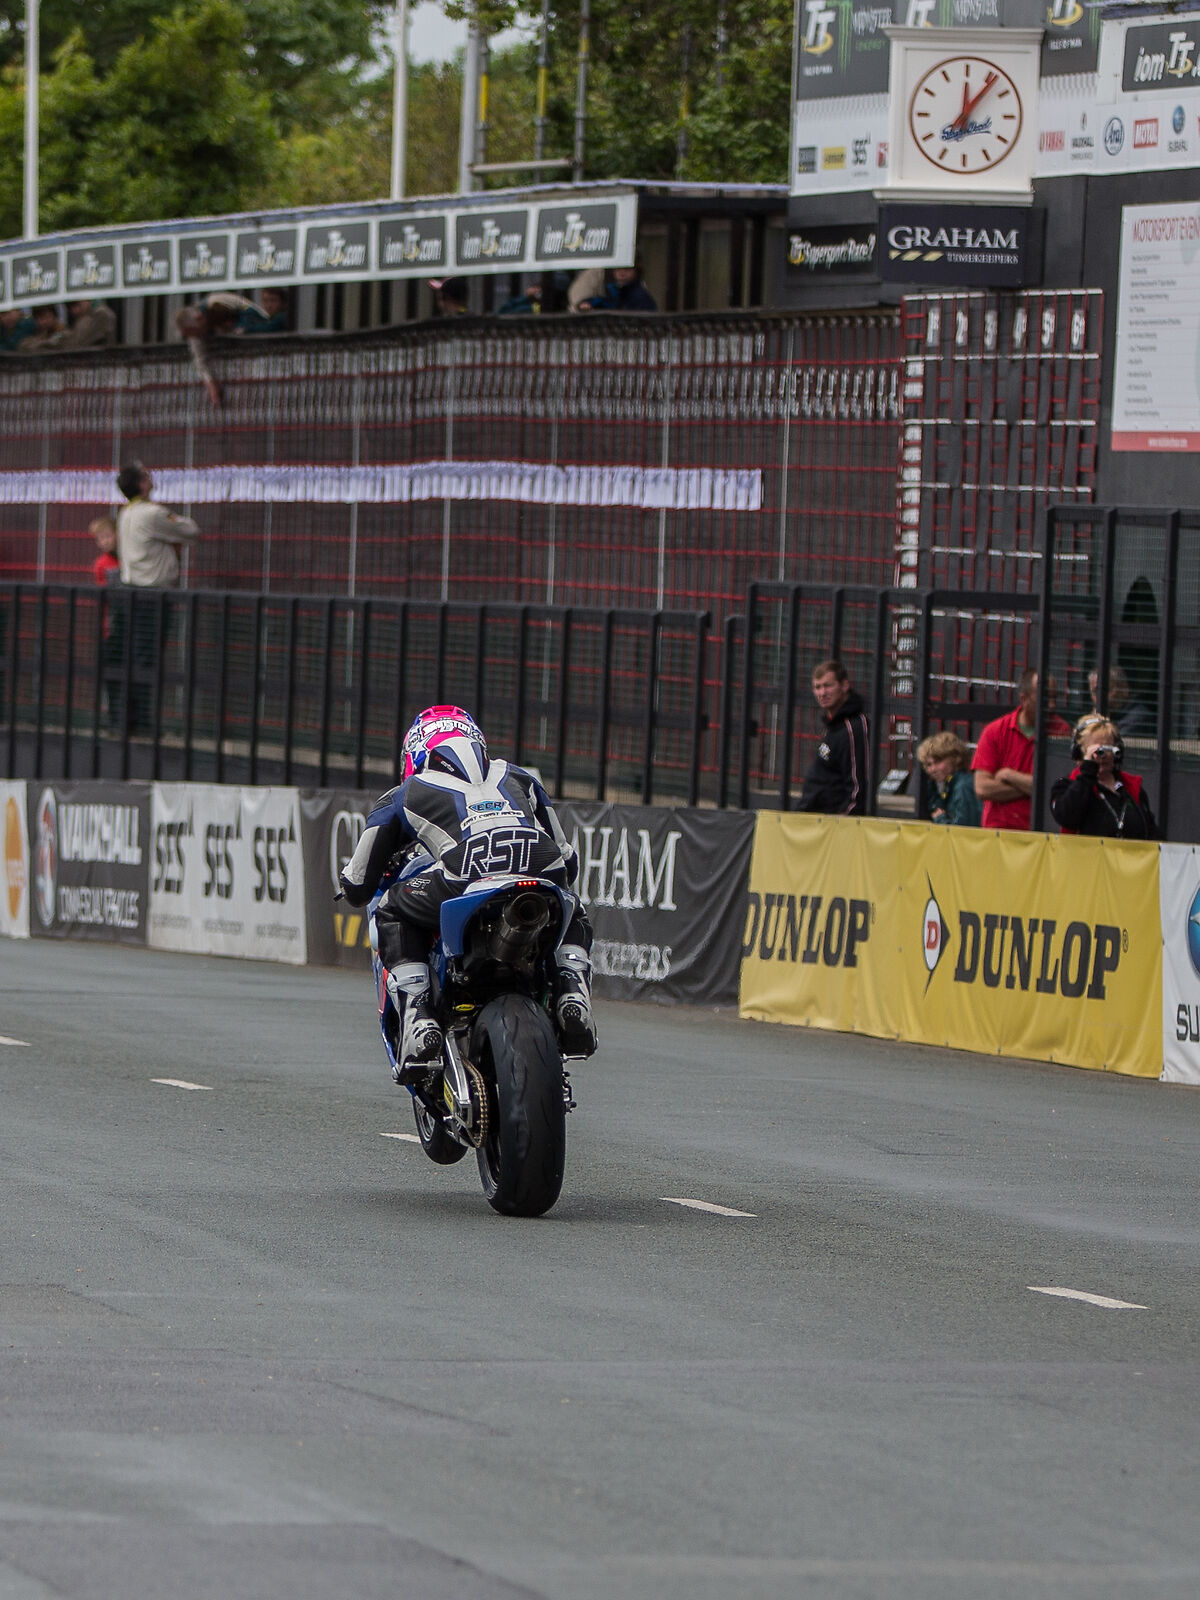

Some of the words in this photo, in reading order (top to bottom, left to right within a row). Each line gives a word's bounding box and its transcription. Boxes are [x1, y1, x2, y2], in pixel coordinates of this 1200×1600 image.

[887, 225, 1020, 250] GRAHAM
[947, 252, 1019, 265] TIMEKEEPERS
[58, 803, 142, 866] VAUXHALL
[460, 826, 540, 878] RST
[742, 890, 872, 968] DUNLOP
[954, 911, 1122, 1000] DUNLOP
